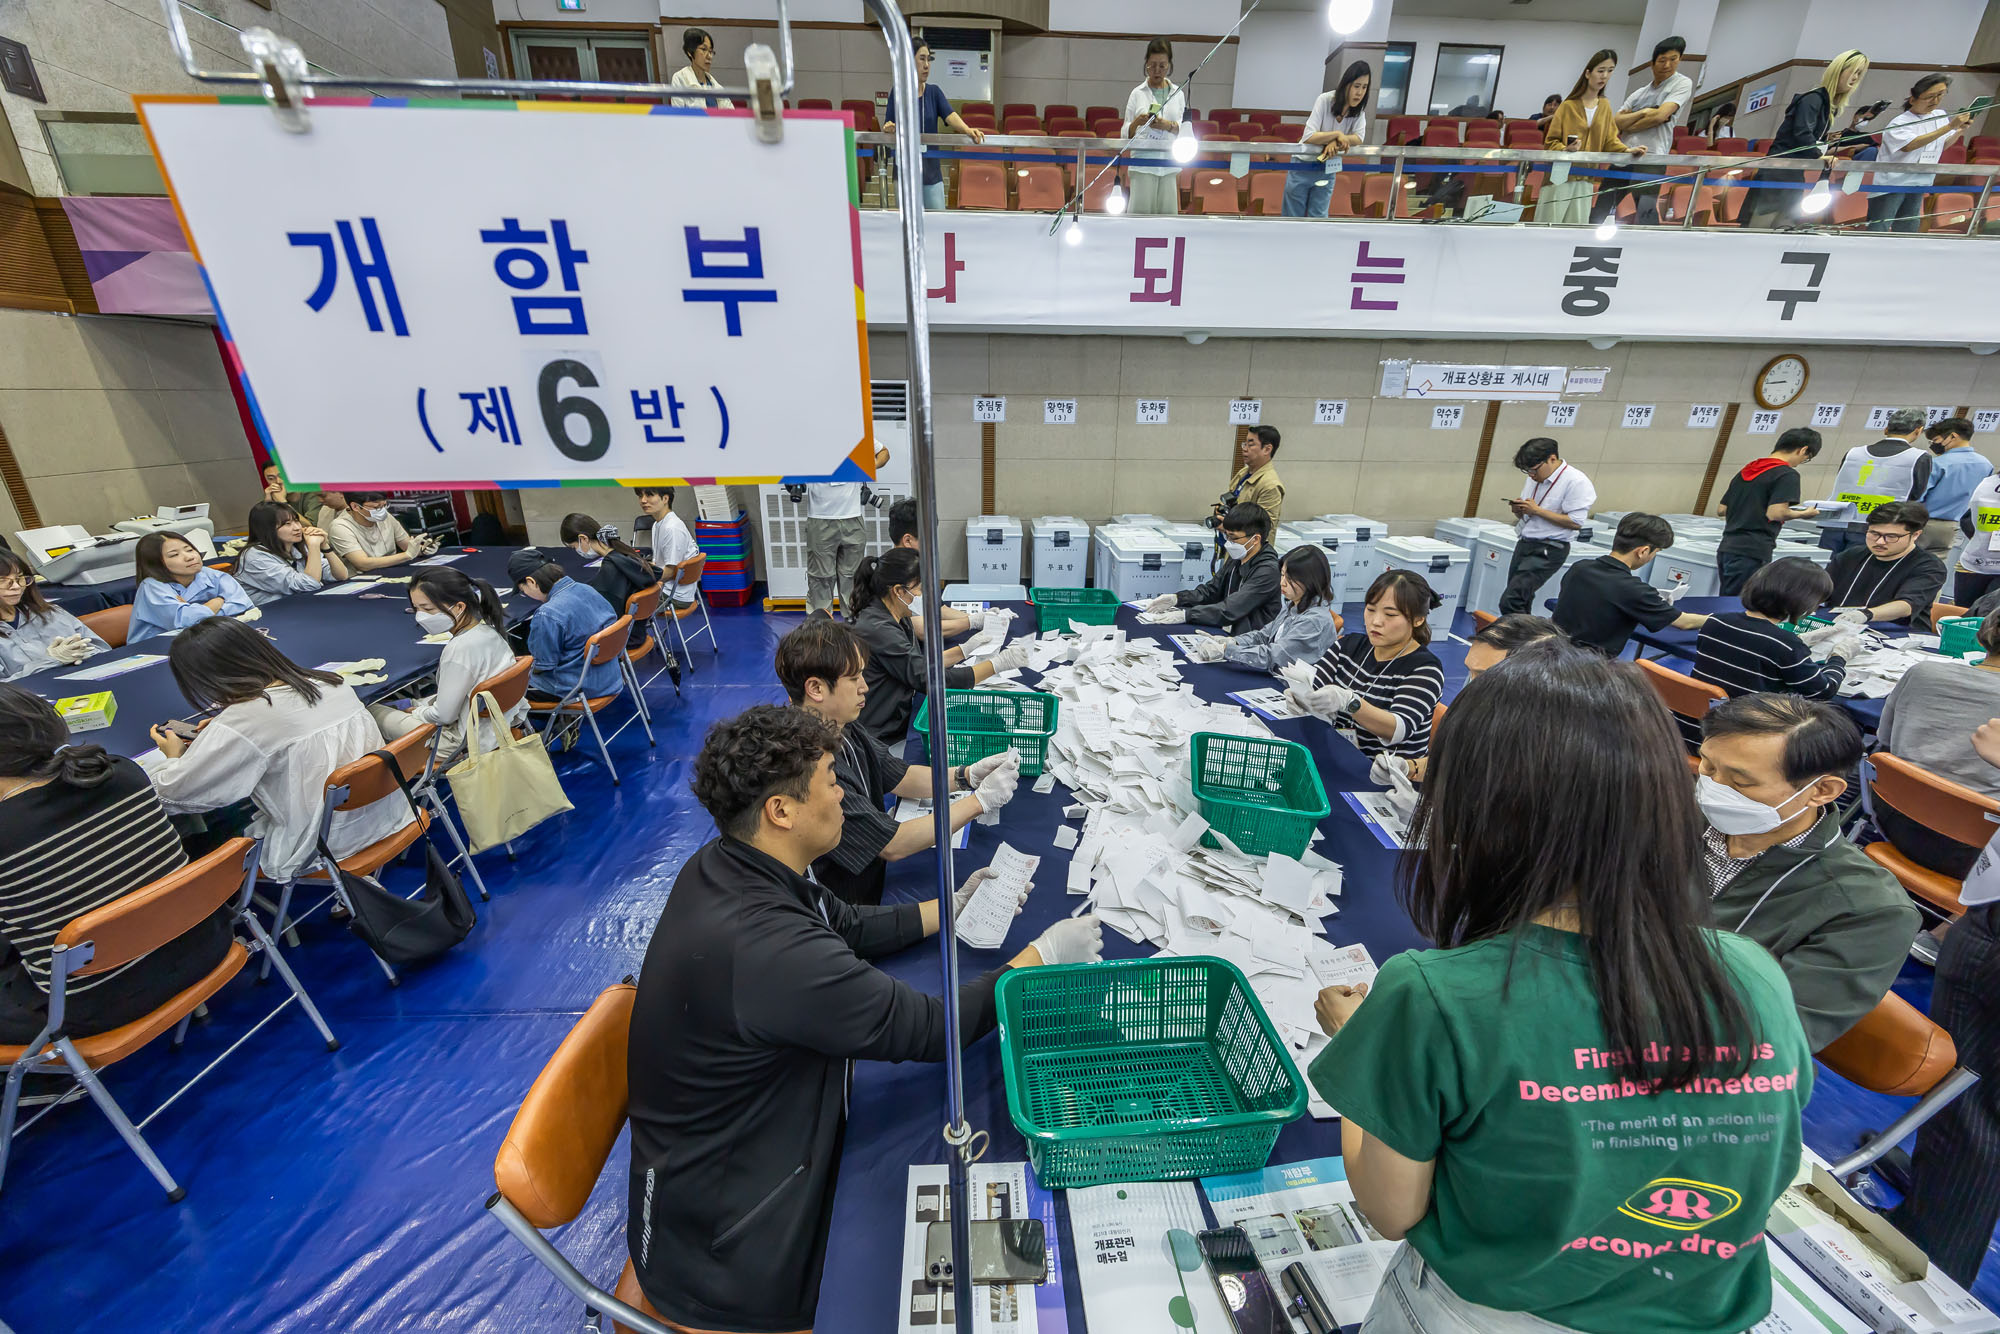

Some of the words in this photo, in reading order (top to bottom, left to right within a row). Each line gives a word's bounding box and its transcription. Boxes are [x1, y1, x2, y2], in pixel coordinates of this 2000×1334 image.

[286, 217, 411, 337] 개
[479, 218, 589, 336] 함
[682, 226, 778, 337] 부
[1130, 236, 1186, 306] 되
[1350, 241, 1406, 310] 는
[1561, 246, 1622, 317] 중
[1766, 252, 1831, 321] 구
[1441, 371, 1505, 386] 개표상황표
[1511, 372, 1550, 387] 게시대
[537, 358, 612, 462] 6
[975, 400, 1003, 412] 중림동
[1047, 402, 1074, 414] 황학동
[1139, 402, 1166, 414] 동화동
[1231, 402, 1260, 413] 신당5동
[1318, 403, 1344, 414] 청구동
[1691, 406, 1720, 417] 을지로동
[1817, 405, 1842, 417] 장충동
[1436, 408, 1461, 420] 약수동
[1626, 407, 1652, 418] 신당동
[1976, 412, 2000, 424] 회현동
[1819, 417, 1832, 425] (2)
[981, 563, 1008, 571] 투표함
[1047, 563, 1074, 571] 투표함
[1620, 1115, 1658, 1129] merit
[1662, 1114, 1677, 1127] of
[1682, 1115, 1703, 1127] an
[1707, 1113, 1754, 1126] action
[1758, 1111, 1784, 1124] lies
[1591, 1138, 1605, 1150] in
[1609, 1134, 1679, 1151] finishing
[1683, 1135, 1693, 1147] it
[1712, 1131, 1739, 1144] the
[1094, 1236, 1135, 1251] 개표관리
[1096, 1250, 1129, 1265] 매뉴얼
